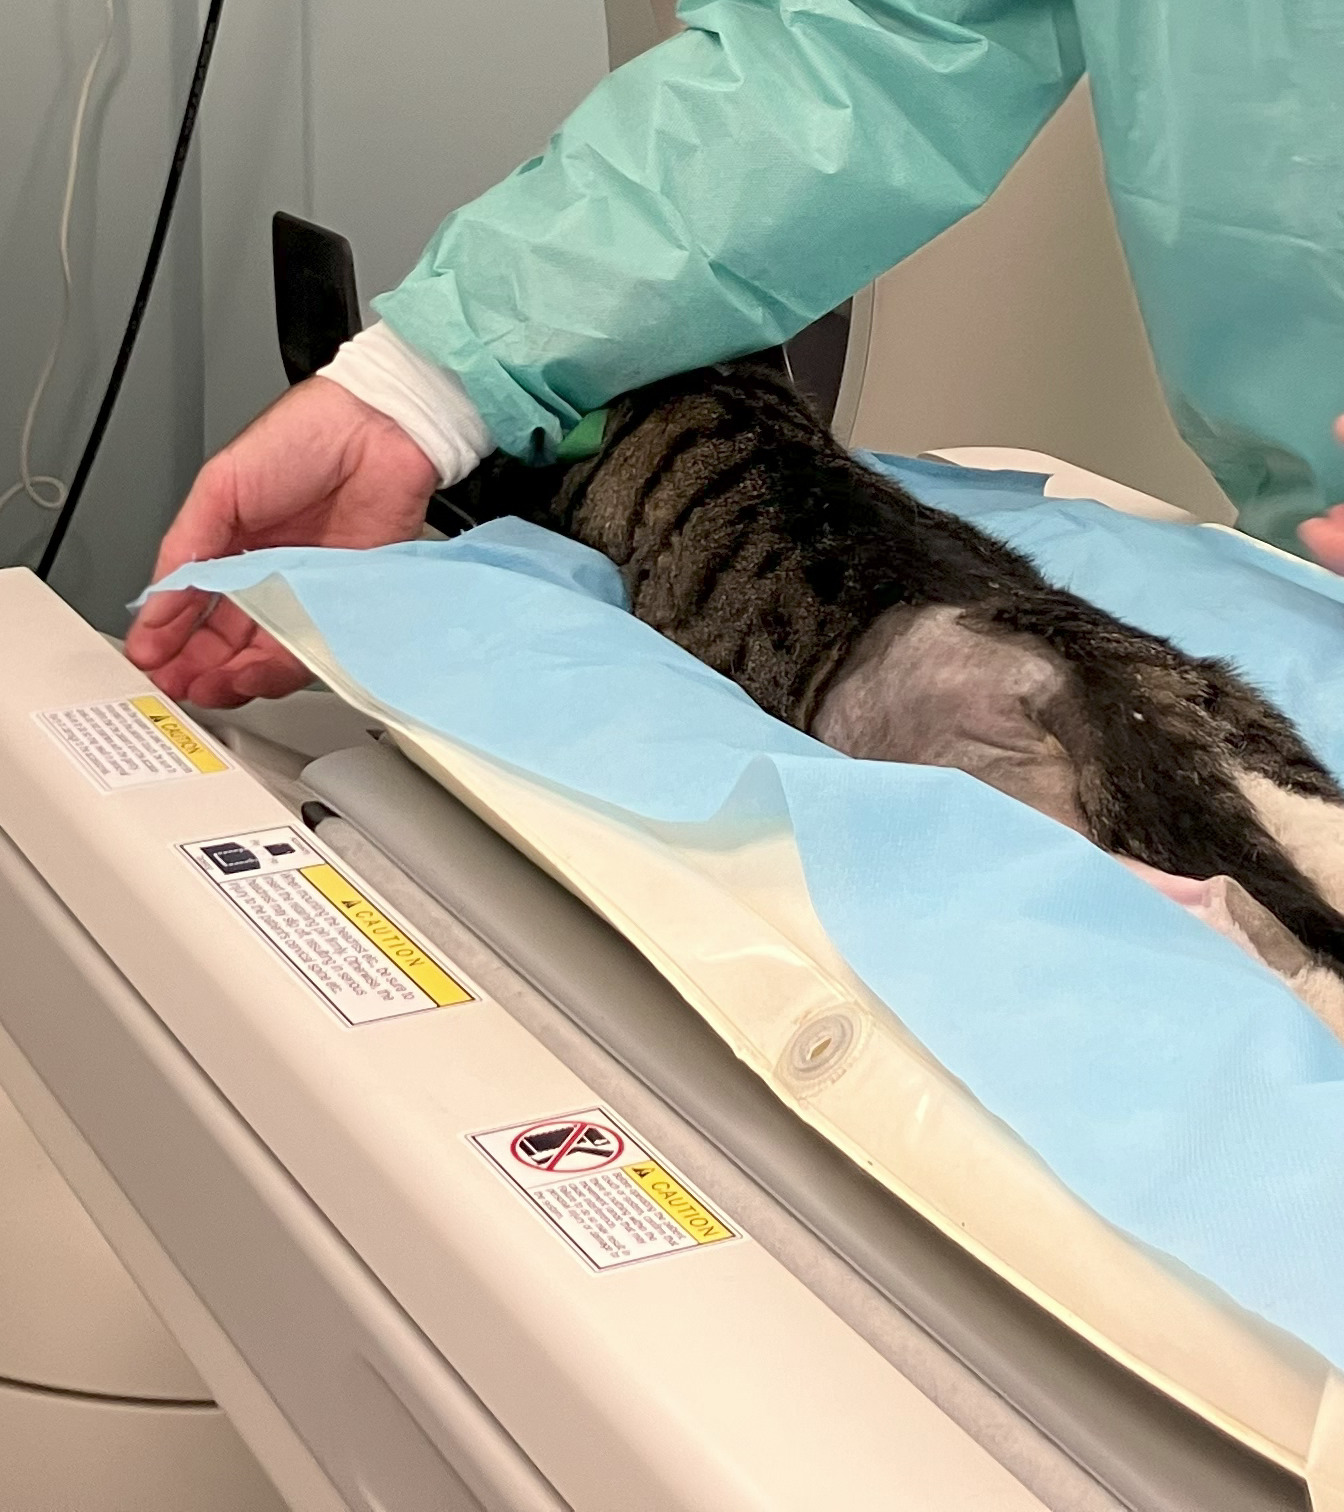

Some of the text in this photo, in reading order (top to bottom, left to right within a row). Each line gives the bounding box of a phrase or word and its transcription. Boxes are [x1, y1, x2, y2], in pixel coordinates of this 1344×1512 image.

[161, 722, 203, 755] CAUTION
[356, 909, 424, 967] CAUTION
[651, 1181, 721, 1238] CAUTION
